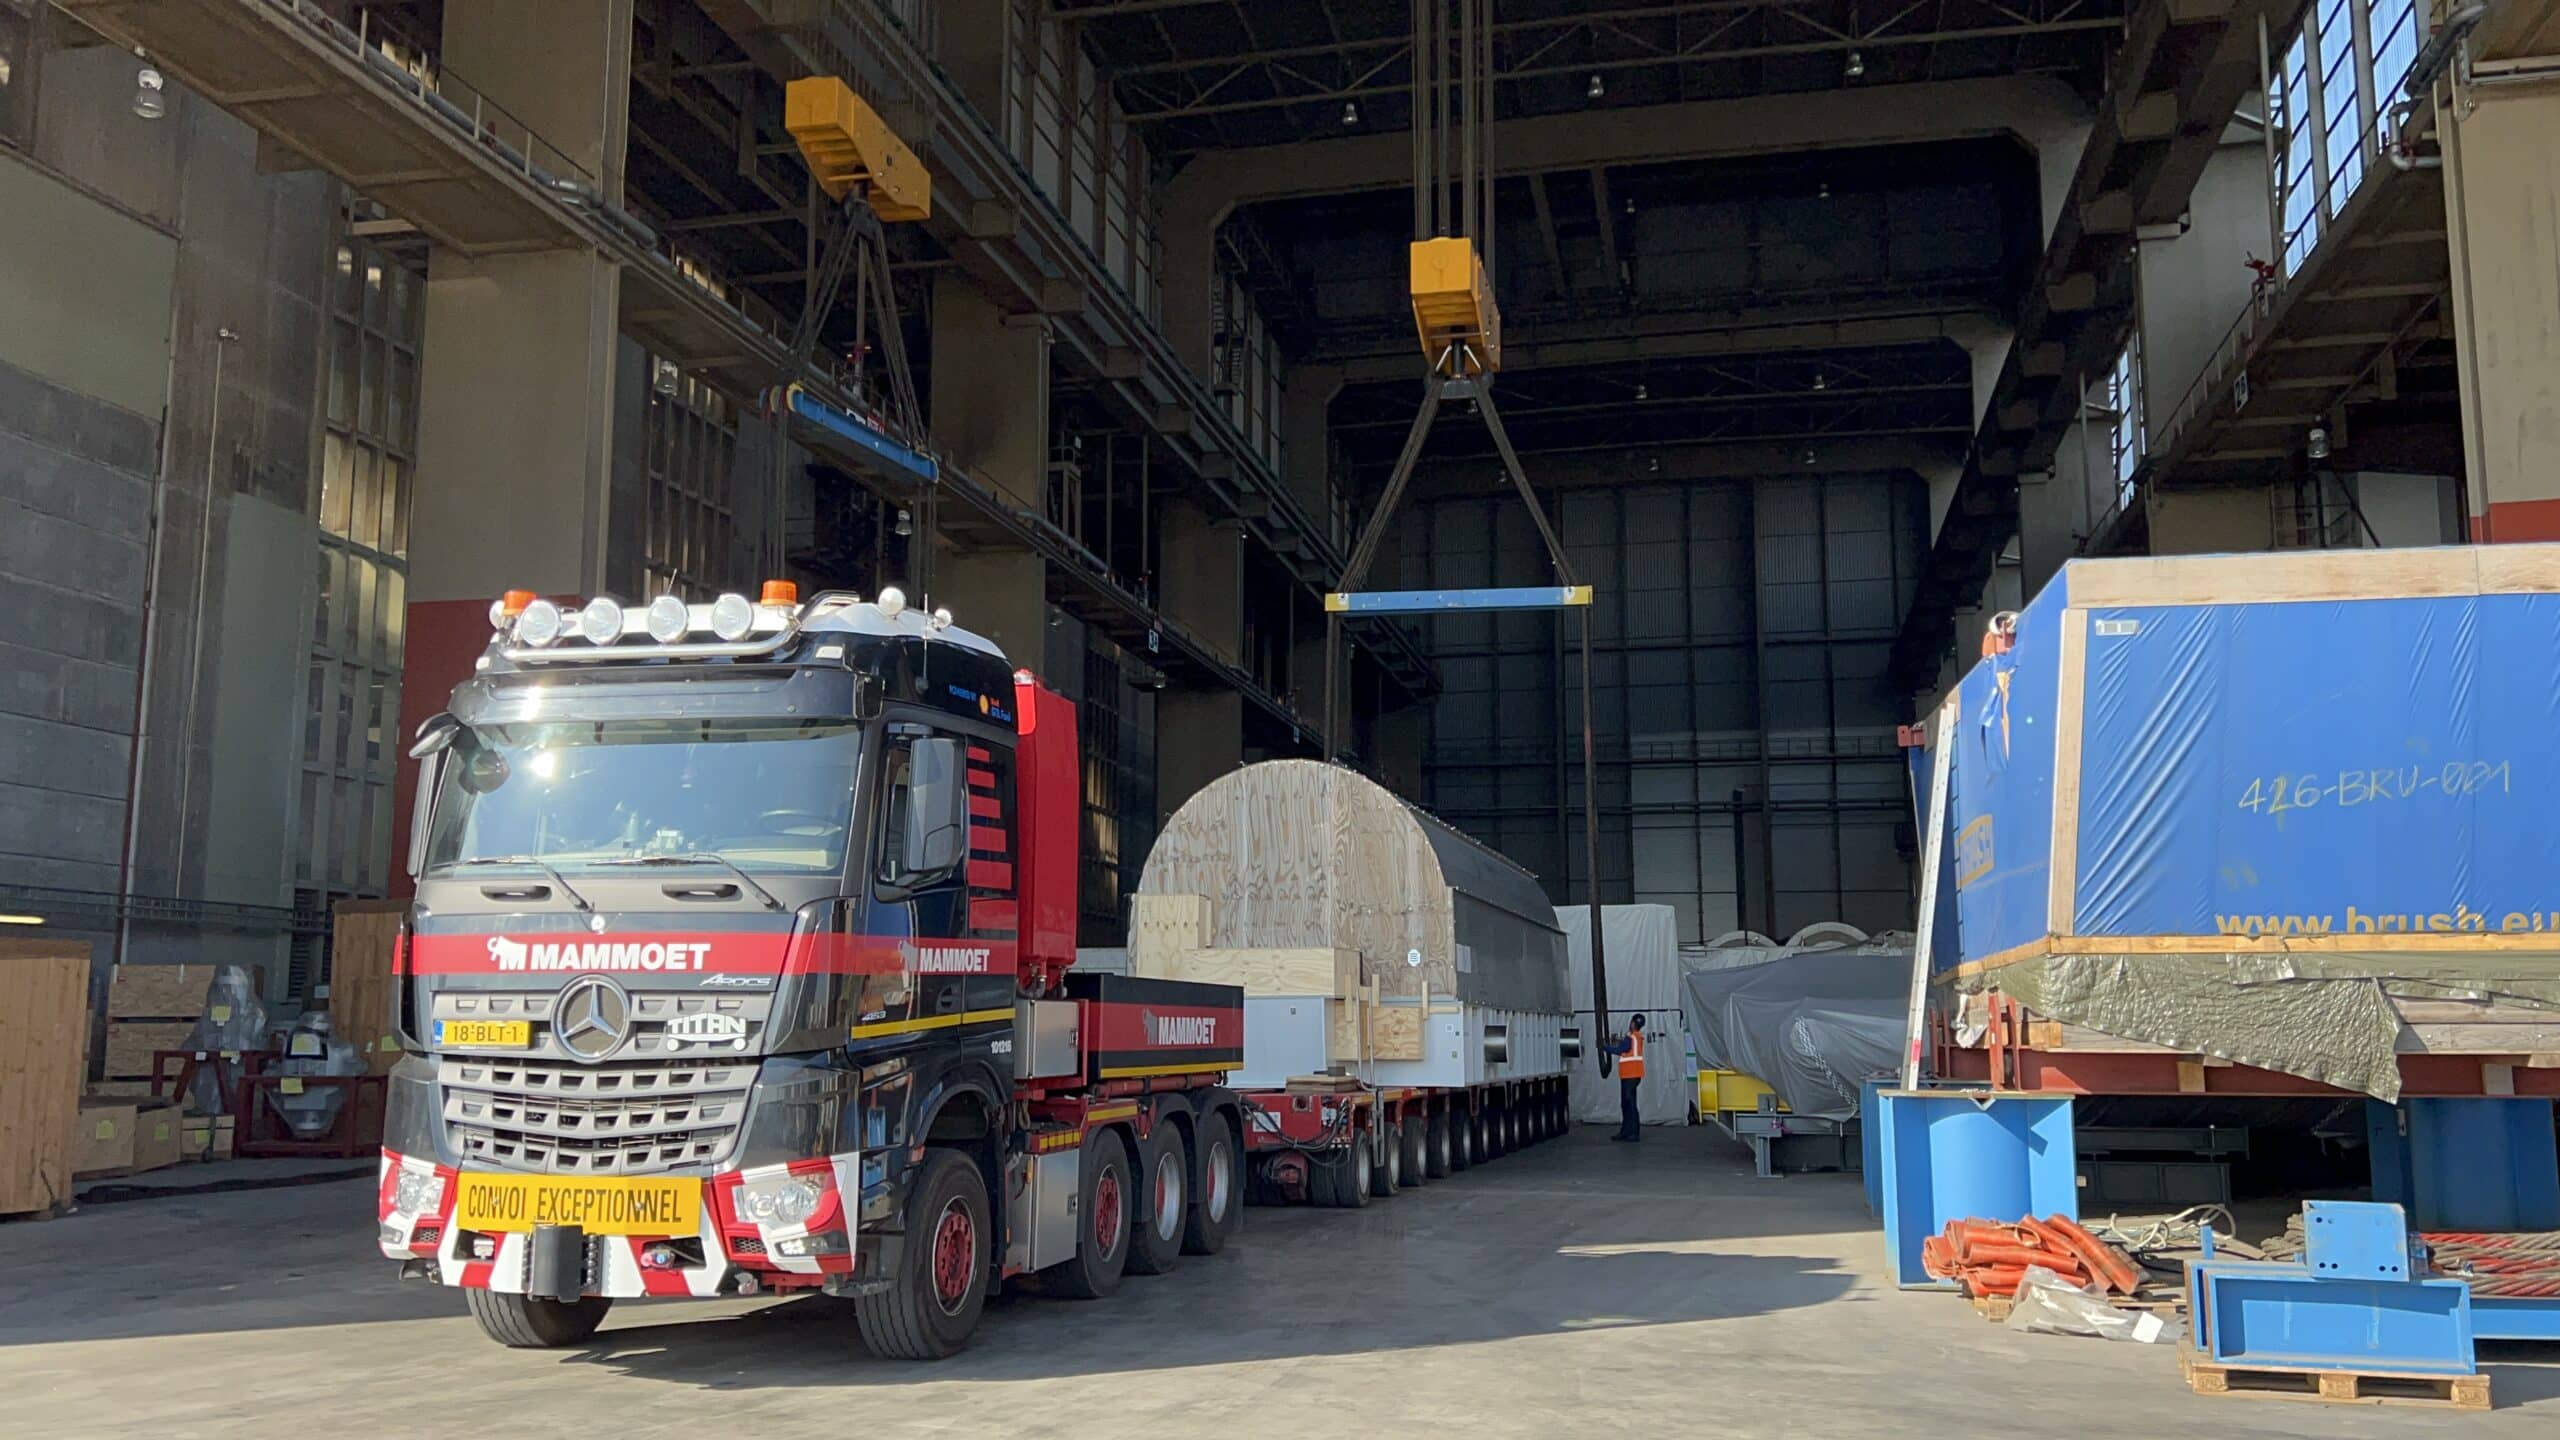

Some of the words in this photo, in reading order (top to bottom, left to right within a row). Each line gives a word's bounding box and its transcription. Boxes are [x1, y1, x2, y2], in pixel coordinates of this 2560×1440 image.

[530, 943, 711, 971] MAMMOET
[919, 947, 990, 973] MAMMOET
[667, 1012, 747, 1035] TITAN
[1158, 1015, 1217, 1046] MAMMOET
[467, 1183, 527, 1220] CONVOI
[537, 1186, 683, 1224] EXCEPTIONNEL
